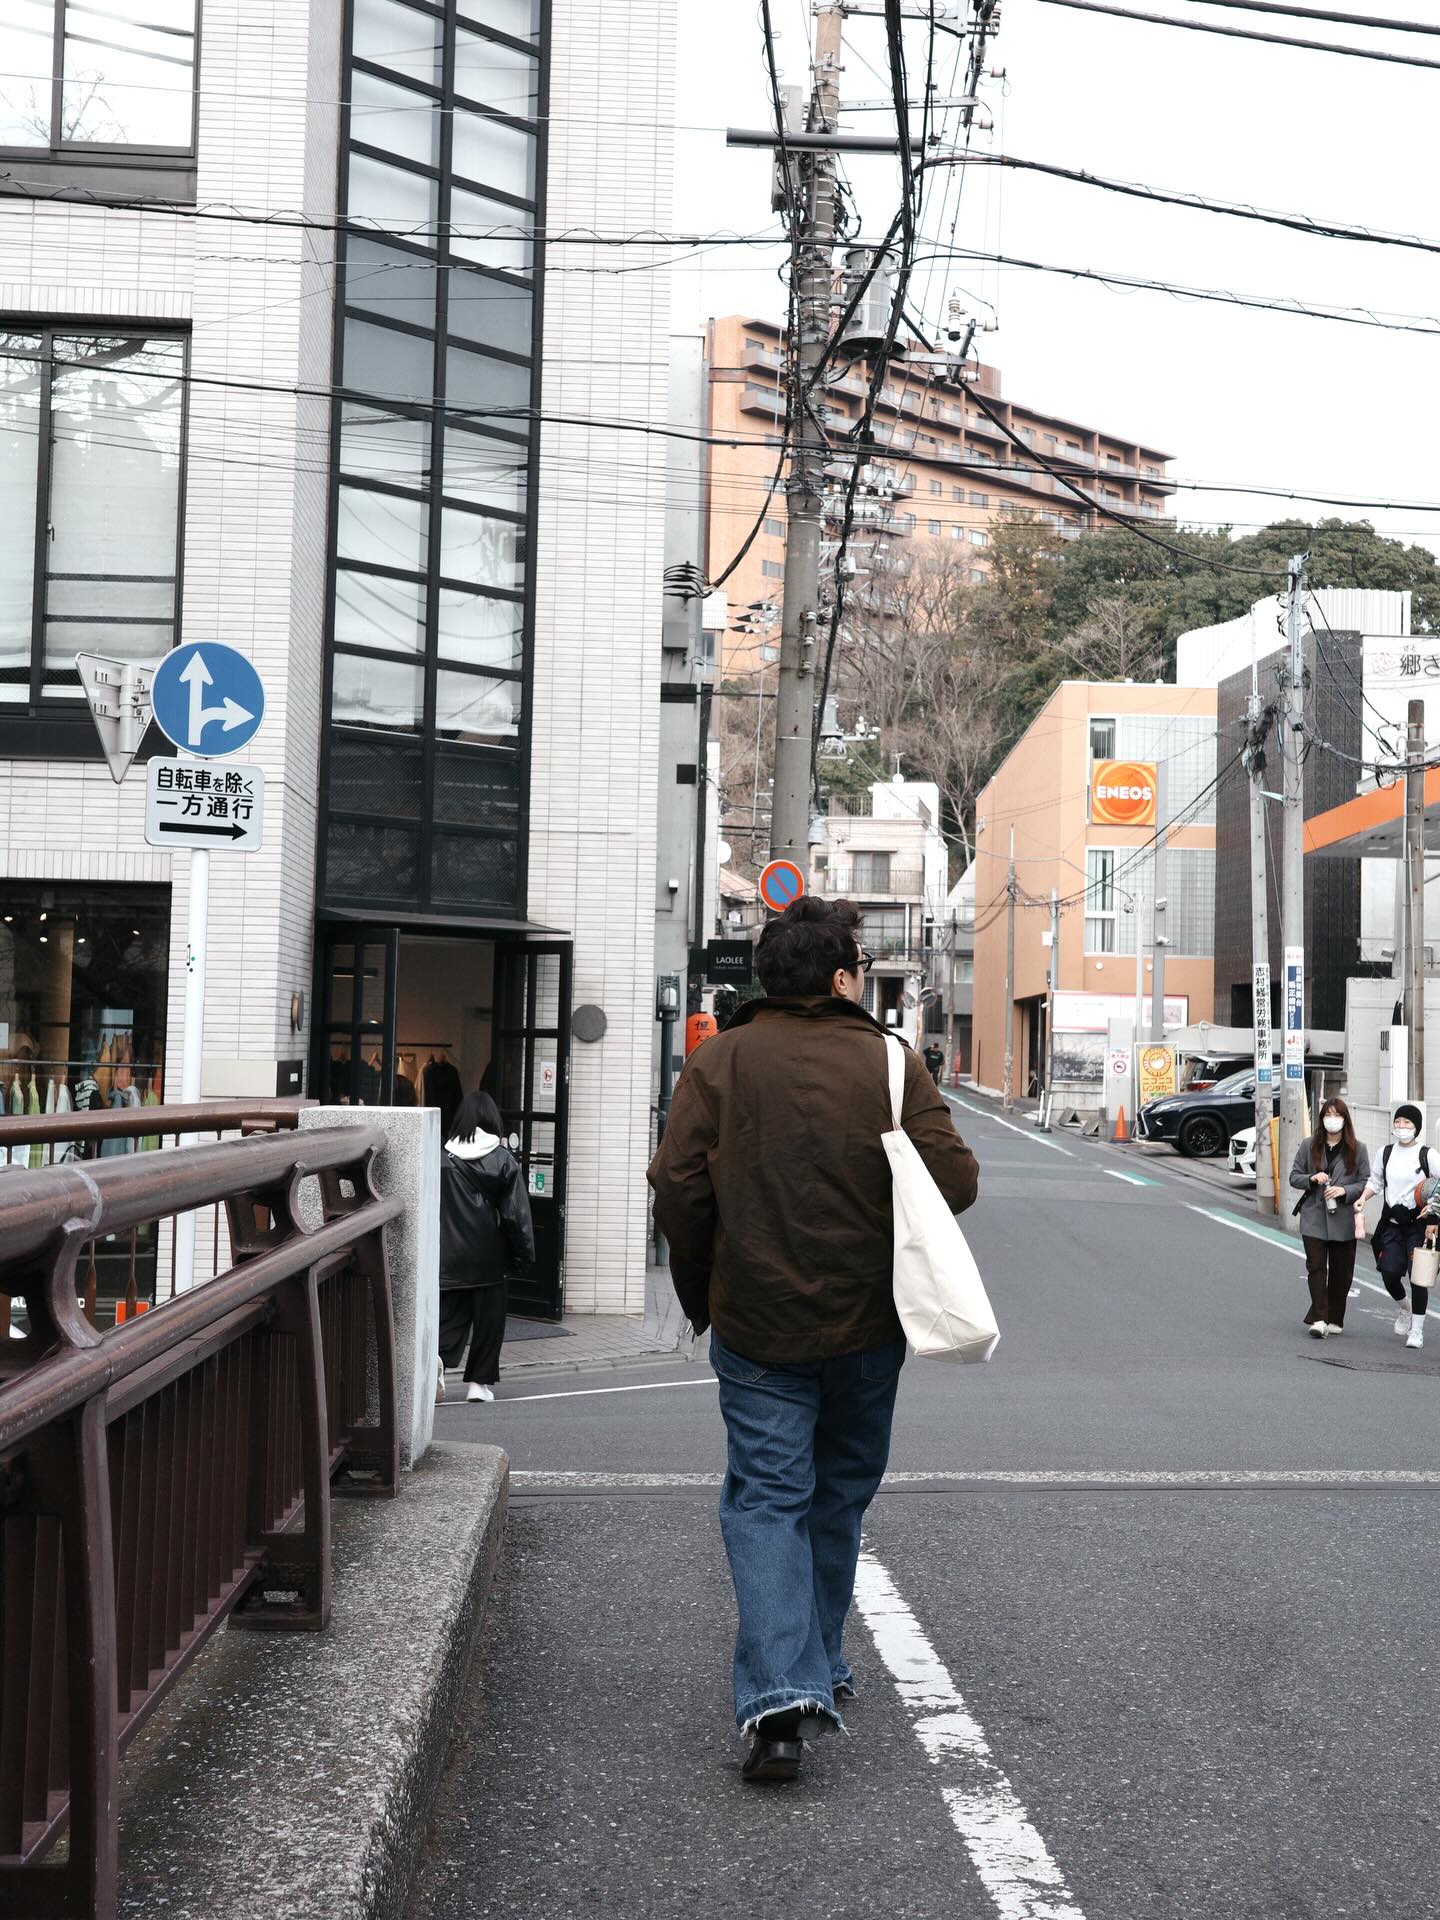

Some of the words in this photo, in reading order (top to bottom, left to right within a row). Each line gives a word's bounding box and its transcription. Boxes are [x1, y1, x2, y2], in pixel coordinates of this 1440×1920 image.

[157, 766, 254, 795] 自転車を除く
[1096, 786, 1152, 801] ENEOS
[156, 794, 254, 819] 一方通行
[716, 957, 744, 965] LAOLEE
[1255, 967, 1267, 1060] 志村経営労務事務所
[1143, 1077, 1172, 1085] ニコニコ
